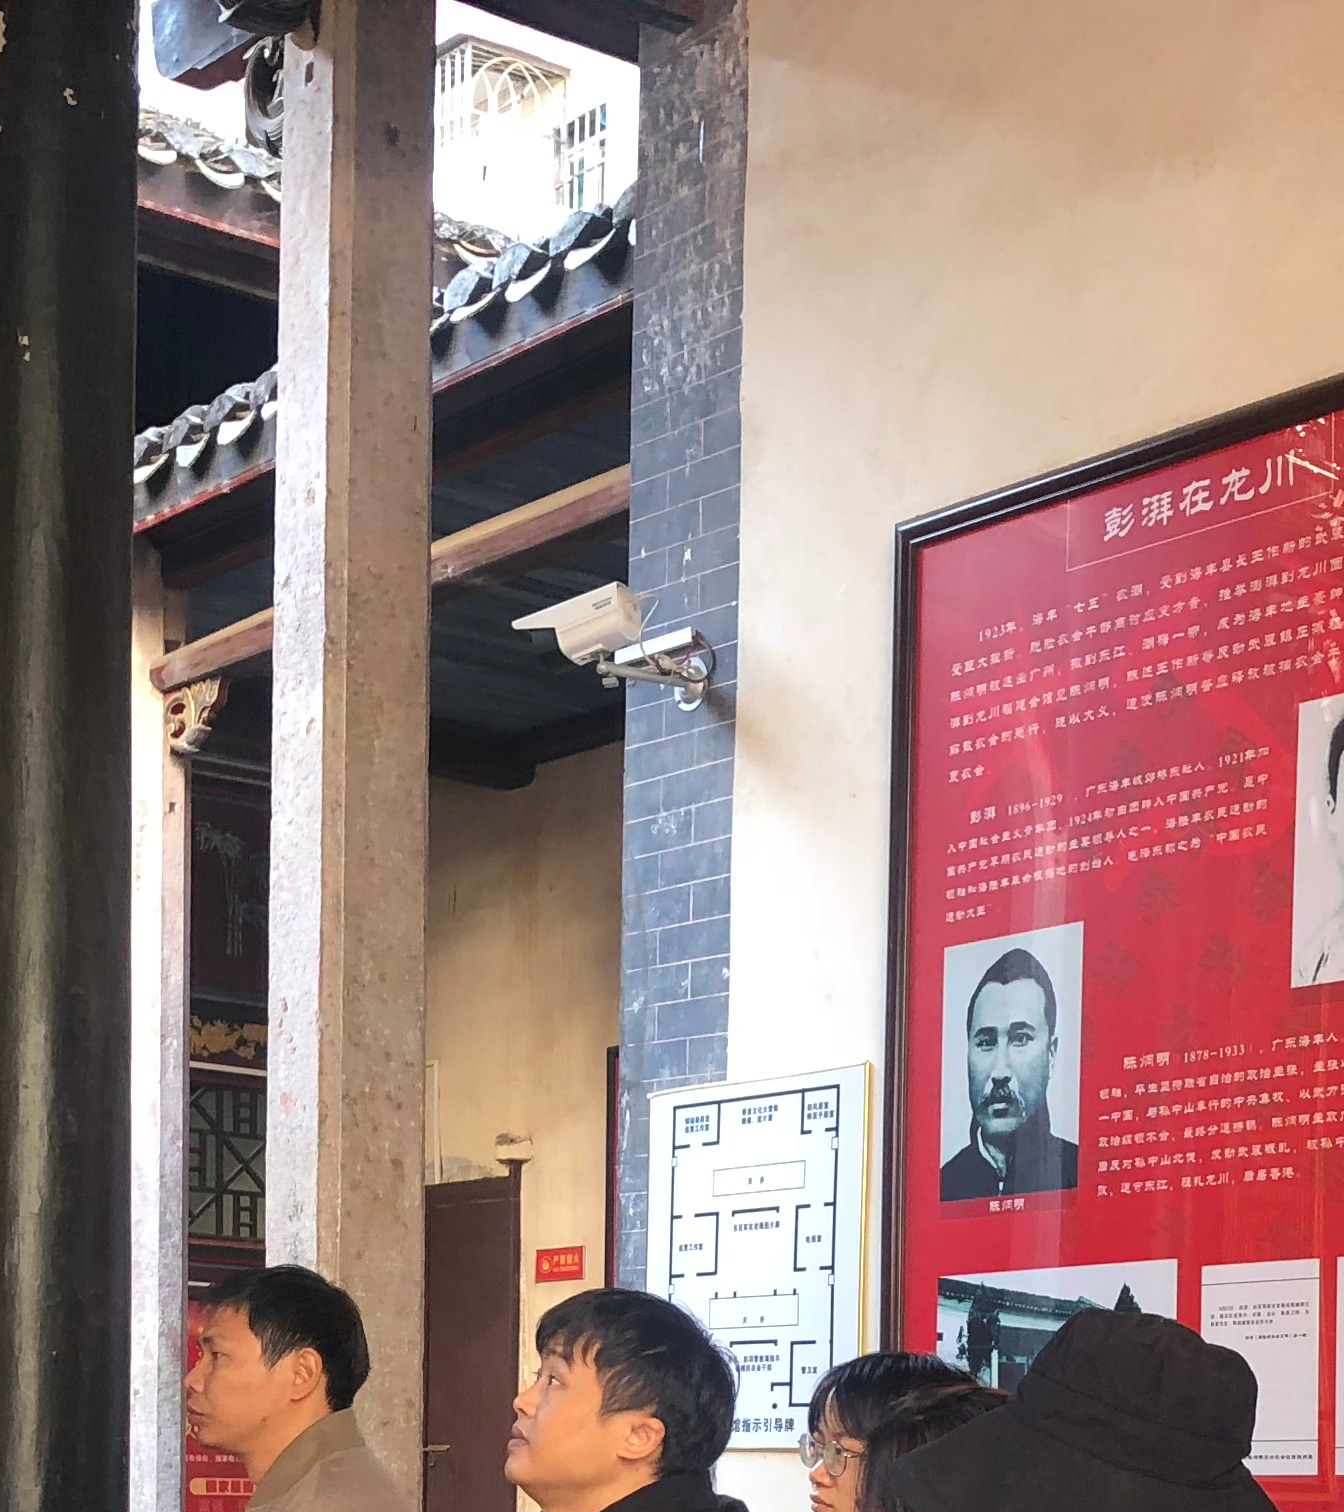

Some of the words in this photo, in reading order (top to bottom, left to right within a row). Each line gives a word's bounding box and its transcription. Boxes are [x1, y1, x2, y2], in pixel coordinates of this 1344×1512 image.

[1104, 450, 1296, 541] 彭湃在龙川
[988, 1197, 1026, 1214] 陈炯明
